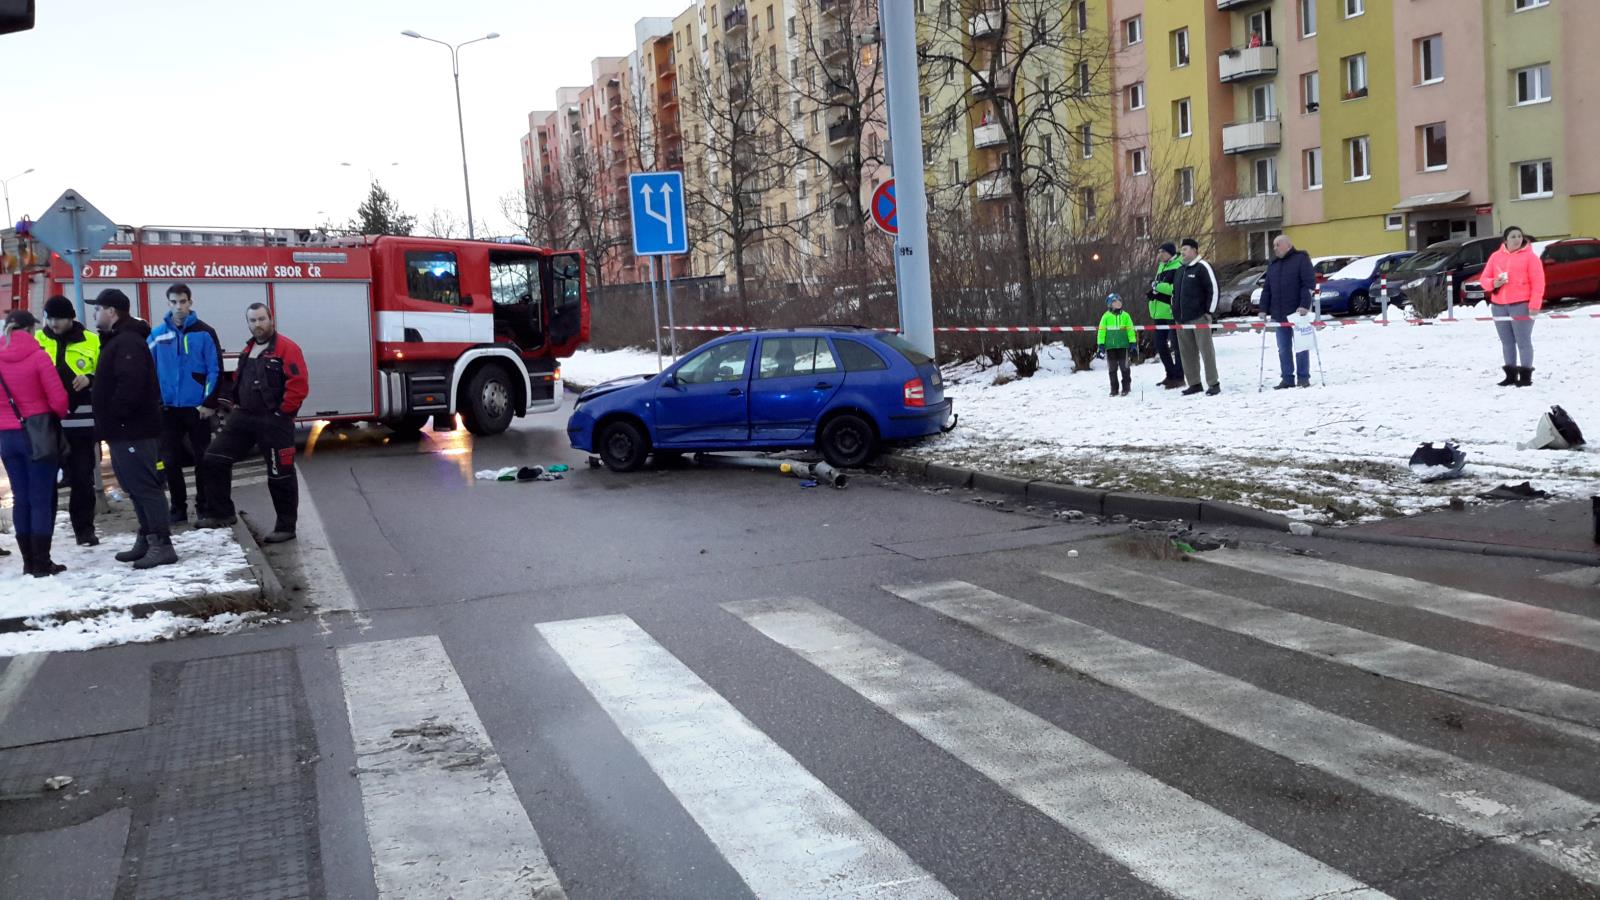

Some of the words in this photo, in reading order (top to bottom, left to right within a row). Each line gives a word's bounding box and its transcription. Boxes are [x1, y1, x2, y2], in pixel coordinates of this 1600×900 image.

[99, 264, 118, 277] 112
[143, 261, 197, 277] HASIČSKÝ
[204, 261, 268, 277] ZÁCHRANNÝ
[274, 265, 302, 277] SBOR
[307, 263, 321, 277] ČR
